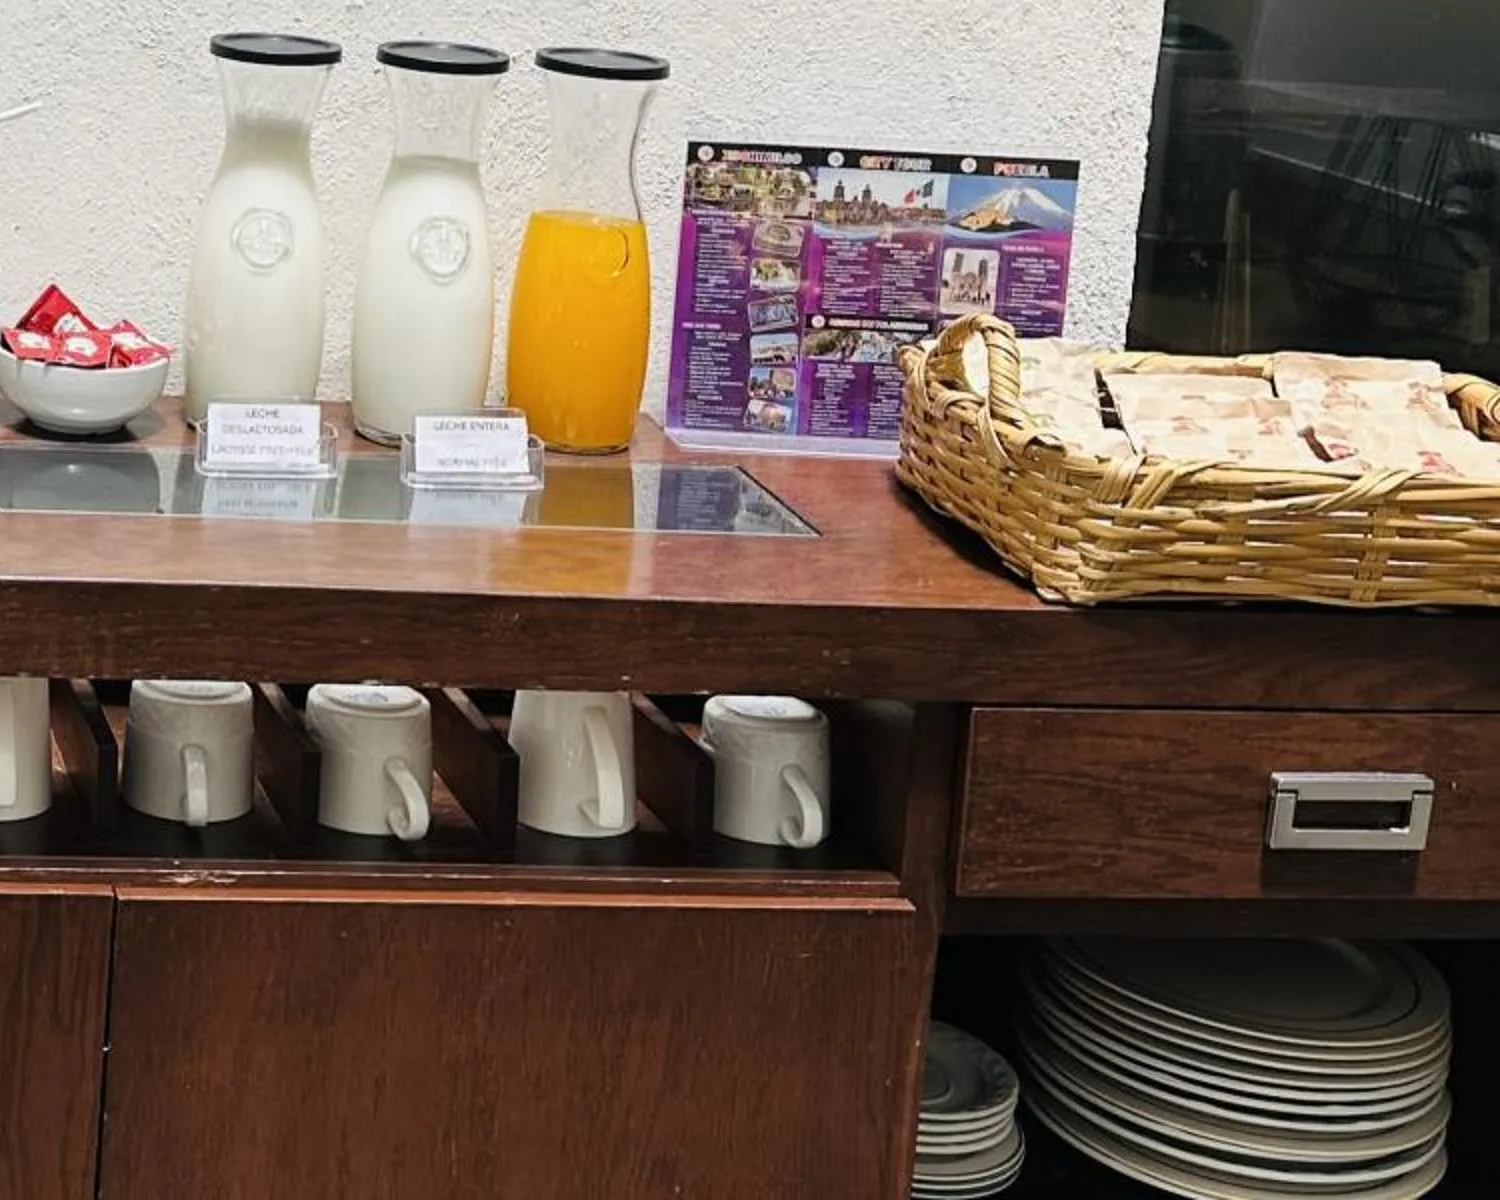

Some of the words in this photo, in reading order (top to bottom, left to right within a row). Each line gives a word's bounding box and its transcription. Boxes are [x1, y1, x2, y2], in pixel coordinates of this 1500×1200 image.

[245, 407, 280, 418] LECHE
[221, 423, 303, 435] DESLACTOSADA
[434, 421, 466, 432] LECHE
[469, 421, 509, 432] ENTERA
